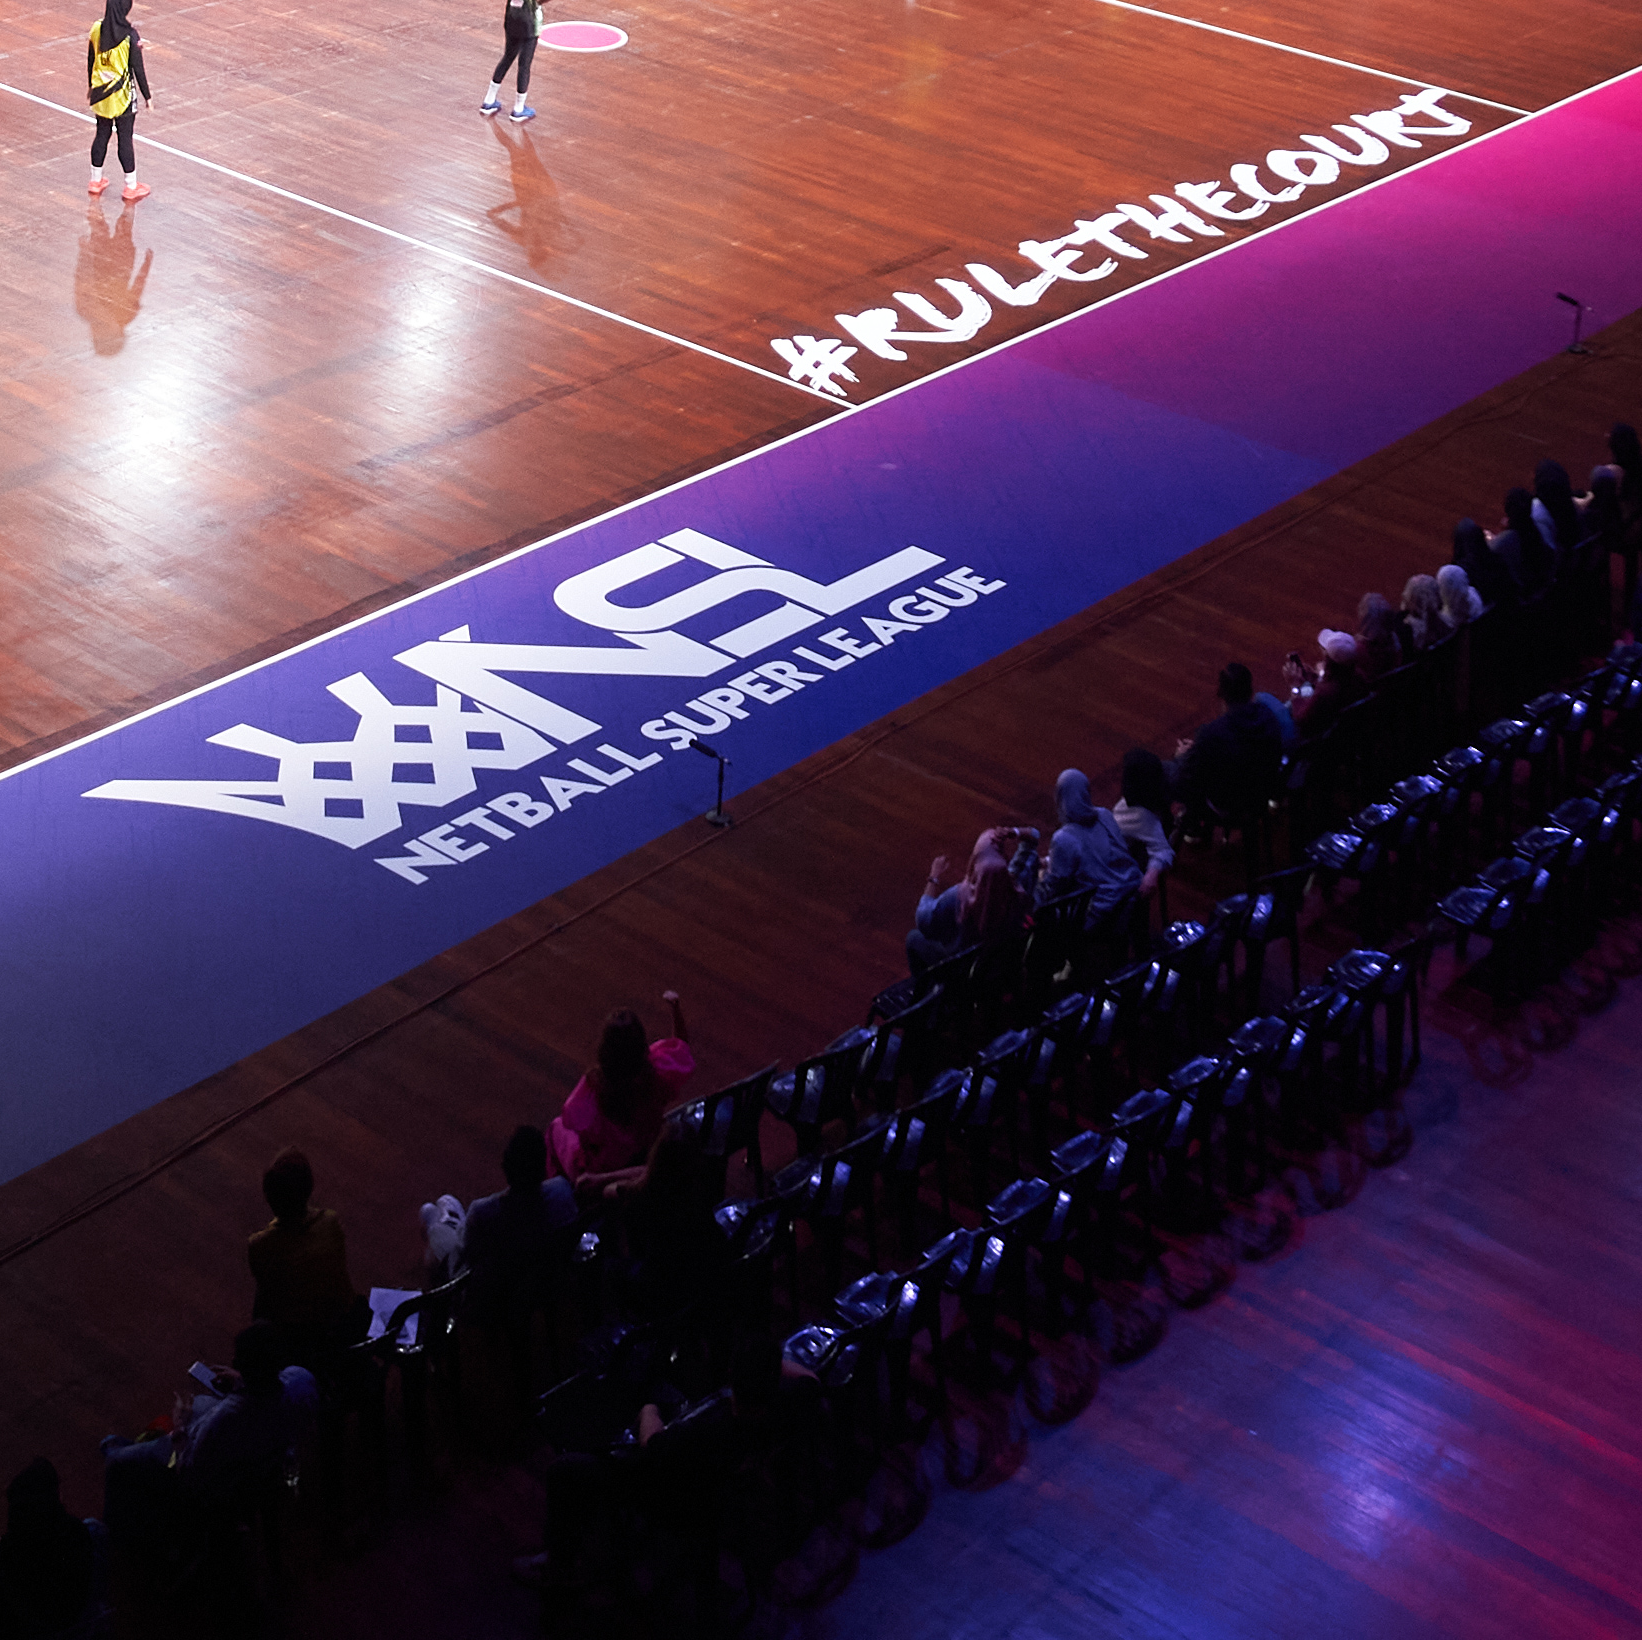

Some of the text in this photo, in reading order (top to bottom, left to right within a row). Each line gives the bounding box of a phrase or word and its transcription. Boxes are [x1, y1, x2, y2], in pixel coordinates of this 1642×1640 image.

[769, 87, 1471, 396] #RULETHECOURT
[373, 566, 1008, 885] NETBALL SUPER LEAGUE
